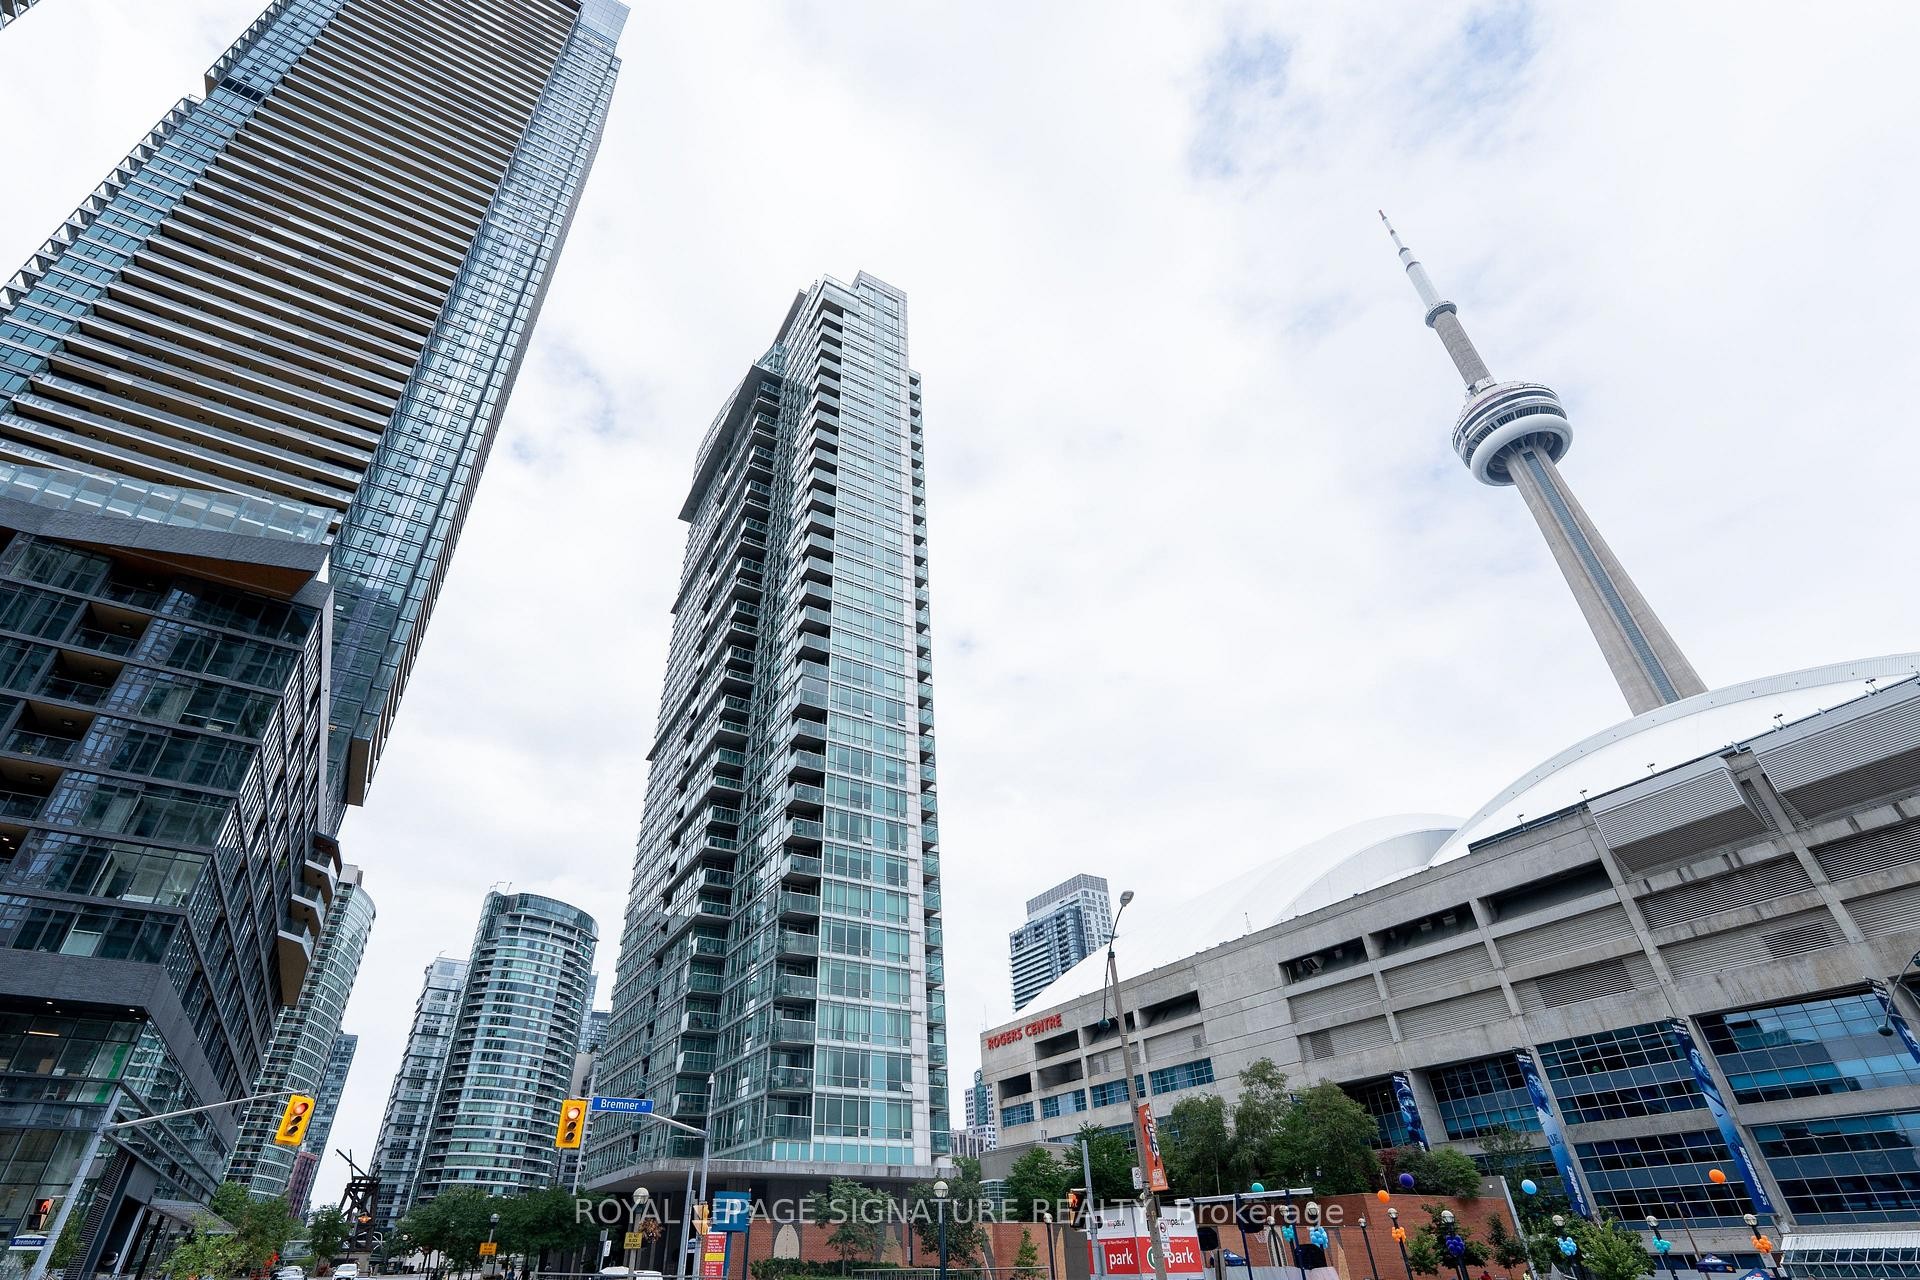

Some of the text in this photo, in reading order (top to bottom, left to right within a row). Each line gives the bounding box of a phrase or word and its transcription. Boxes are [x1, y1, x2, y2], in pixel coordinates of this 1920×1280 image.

[987, 1013, 1063, 1050] ROGERS CENTRE
[600, 1098, 639, 1110] Bremner
[1109, 1247, 1134, 1270] park
[1167, 1246, 1195, 1269] park
